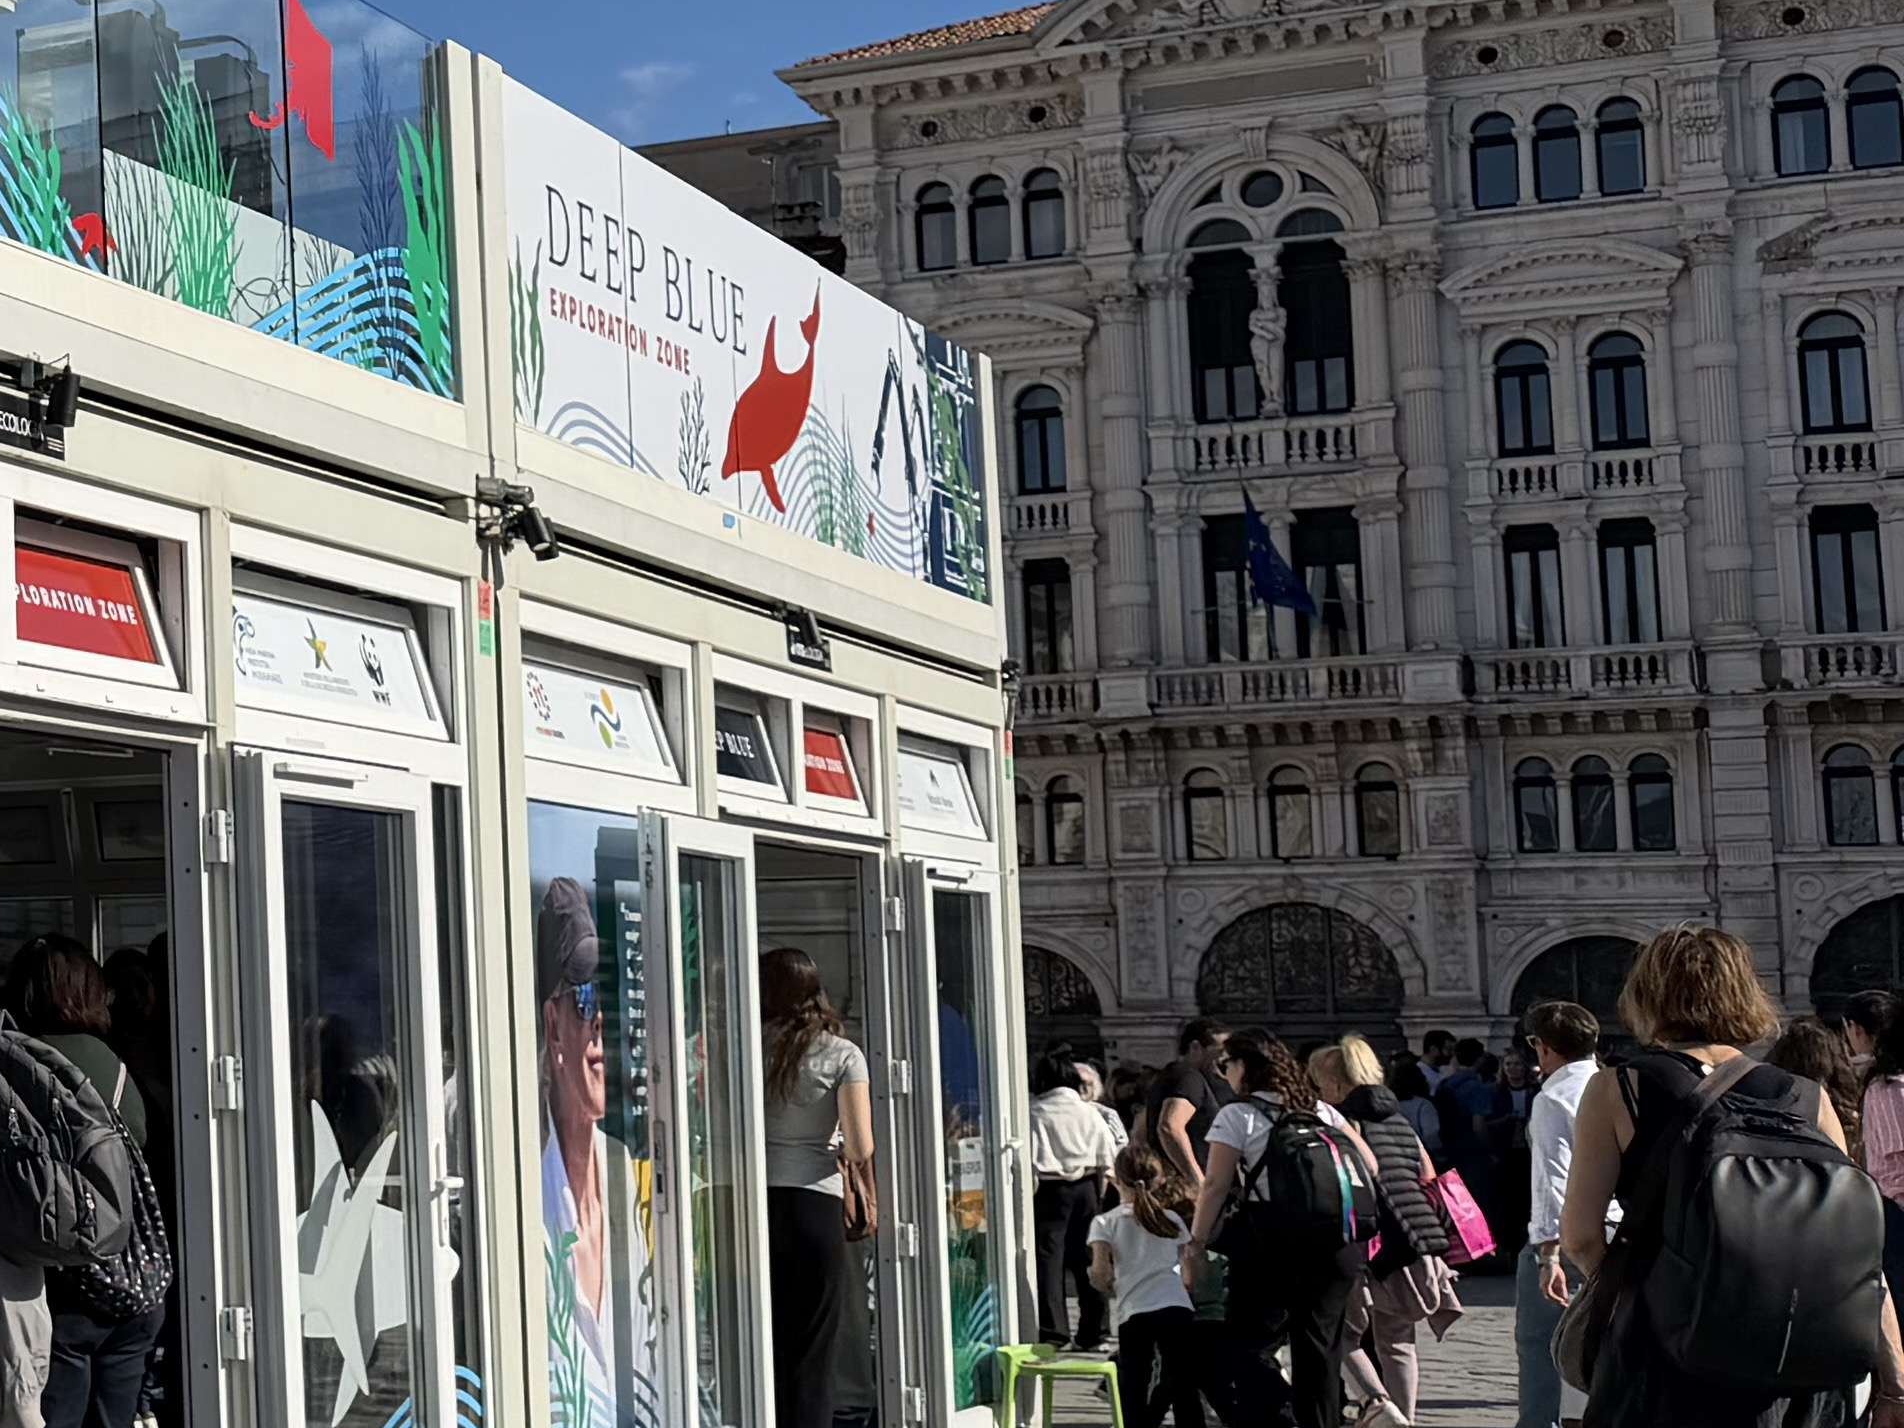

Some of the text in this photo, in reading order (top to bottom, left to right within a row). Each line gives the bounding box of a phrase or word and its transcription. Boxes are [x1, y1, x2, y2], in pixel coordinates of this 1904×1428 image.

[546, 185, 747, 356] DEEP BLUE
[550, 288, 691, 375] EXPLORATION ZONE
[16, 582, 138, 626] PLORATION ZONE
